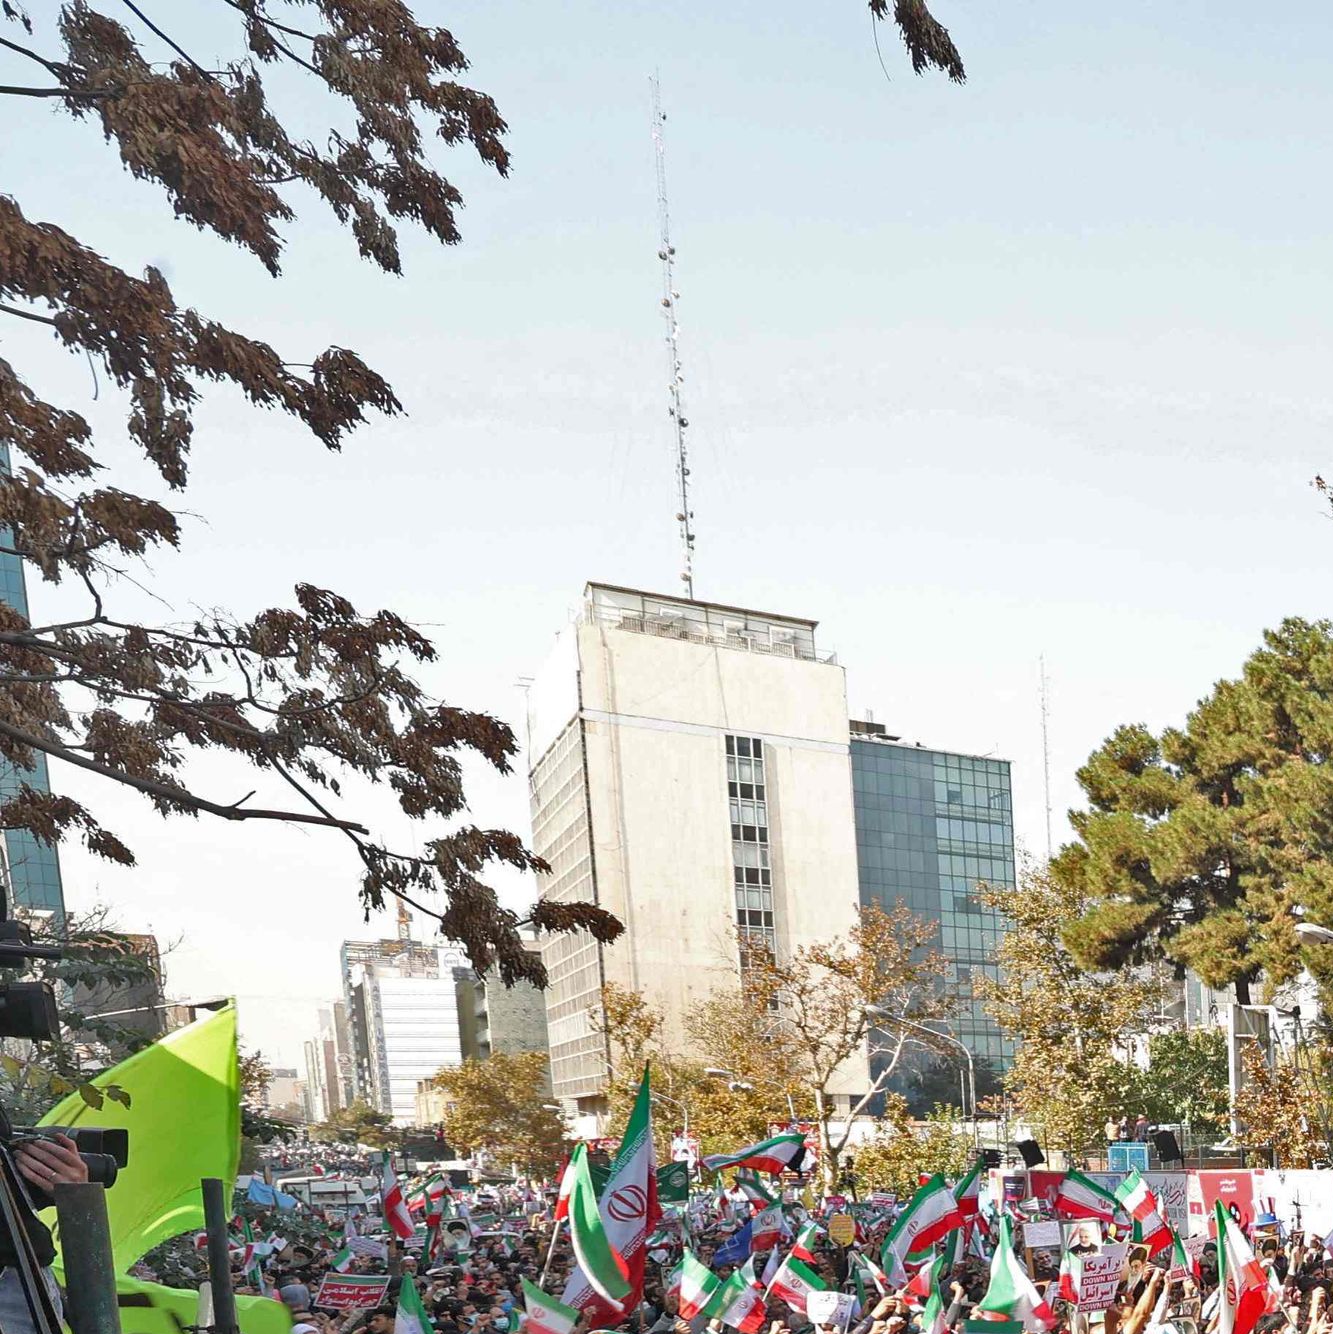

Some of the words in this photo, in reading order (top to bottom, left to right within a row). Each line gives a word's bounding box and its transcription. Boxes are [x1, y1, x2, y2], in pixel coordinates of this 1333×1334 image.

[1083, 1256, 1112, 1275] آمریکا
[1083, 1276, 1106, 1285] DOWN
[323, 1287, 358, 1295] اسلامی
[1080, 1284, 1113, 1302] اسرائیل
